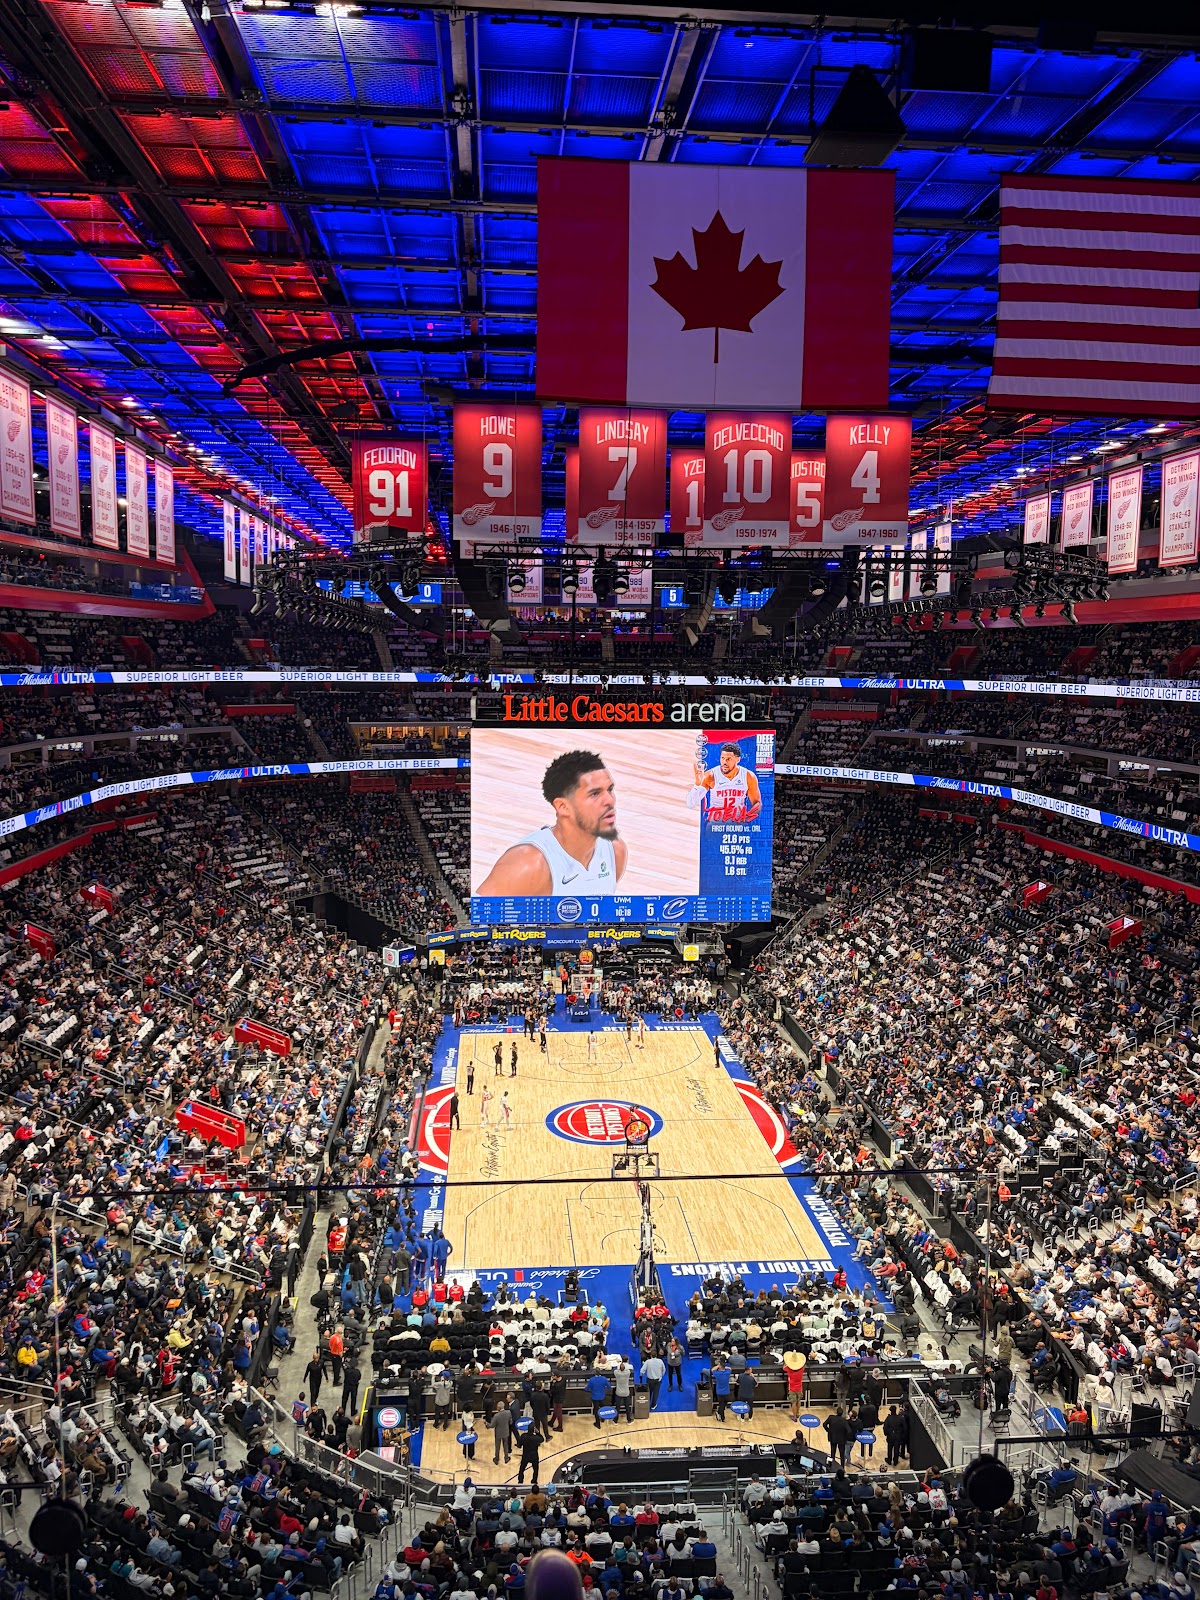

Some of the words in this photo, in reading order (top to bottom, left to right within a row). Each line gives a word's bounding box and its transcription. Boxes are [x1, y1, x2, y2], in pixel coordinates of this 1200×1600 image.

[480, 416, 516, 437] HOWE
[596, 420, 649, 445] LINDSAY
[714, 423, 784, 451] DELVECCHIO
[850, 424, 891, 446] KELLY
[363, 447, 417, 470] FEDOROV
[483, 443, 512, 498] 9
[608, 447, 638, 500] 7
[1171, 462, 1193, 474] DETROIT
[723, 449, 772, 503] 10
[851, 450, 881, 504] 4
[1168, 477, 1177, 485] RED
[1179, 472, 1196, 483] WINGS
[1116, 478, 1134, 489] DETROIT
[368, 470, 412, 517] 91
[796, 483, 821, 527] 5
[490, 524, 529, 534] 1946-1971
[615, 521, 656, 530] 1944-1957
[1169, 521, 1191, 531] STANLEY
[736, 529, 777, 538] 1950-1974
[858, 529, 898, 538] 1947-1960
[1114, 532, 1132, 541] STANLEY
[1174, 533, 1184, 541] CUP
[1165, 542, 1193, 553] CHAMPIONS
[423, 584, 431, 598] 0
[669, 589, 677, 602] 5
[17, 672, 52, 686] Michelob
[61, 672, 95, 684] ULTRA
[126, 672, 180, 681] SUPERIOR
[183, 672, 212, 681] LIGHT
[214, 672, 243, 681] BEER
[280, 673, 332, 681] SUPERIOR
[336, 672, 368, 681] LIGHT
[372, 673, 400, 681] BEER
[857, 678, 897, 689] Michelob
[906, 680, 946, 690] ULTRA
[977, 681, 1027, 692] SUPERIOR
[1030, 684, 1057, 693] LIGHT
[1061, 684, 1087, 695] BEER
[1116, 686, 1155, 698] SUPERIOR
[1157, 688, 1183, 699] LIGHT
[503, 695, 569, 722] Little
[571, 695, 664, 723] Caesars
[670, 702, 746, 723] arena
[322, 761, 373, 771] SUPERIOR
[378, 760, 408, 769] LIGHT
[413, 759, 440, 768] BEER
[207, 769, 242, 782] Michelob
[251, 764, 291, 777] ULTRA
[786, 765, 838, 776] SUPERIOR
[842, 769, 870, 779] LIGHT
[873, 772, 899, 782] BEER
[97, 783, 130, 799] SUPERIOR
[133, 778, 156, 792] LIGHT
[158, 775, 178, 787] BEER
[716, 789, 745, 797] PISTONS
[929, 777, 960, 791] Michelob
[968, 782, 1002, 797] ULTRA
[62, 796, 83, 813] ULTRA
[723, 798, 736, 808] 12
[1016, 790, 1048, 810] SUPERIOR
[1049, 799, 1069, 815] LIGHT
[1071, 805, 1090, 820] BEER
[1112, 815, 1143, 835] Michelob
[1152, 824, 1189, 847] ULTRA
[591, 903, 599, 917] 0
[647, 903, 655, 917] 5
[584, 1108, 605, 1136] DETROIT
[602, 1107, 625, 1135] PISTONS
[758, 1261, 838, 1274] DETROIT
